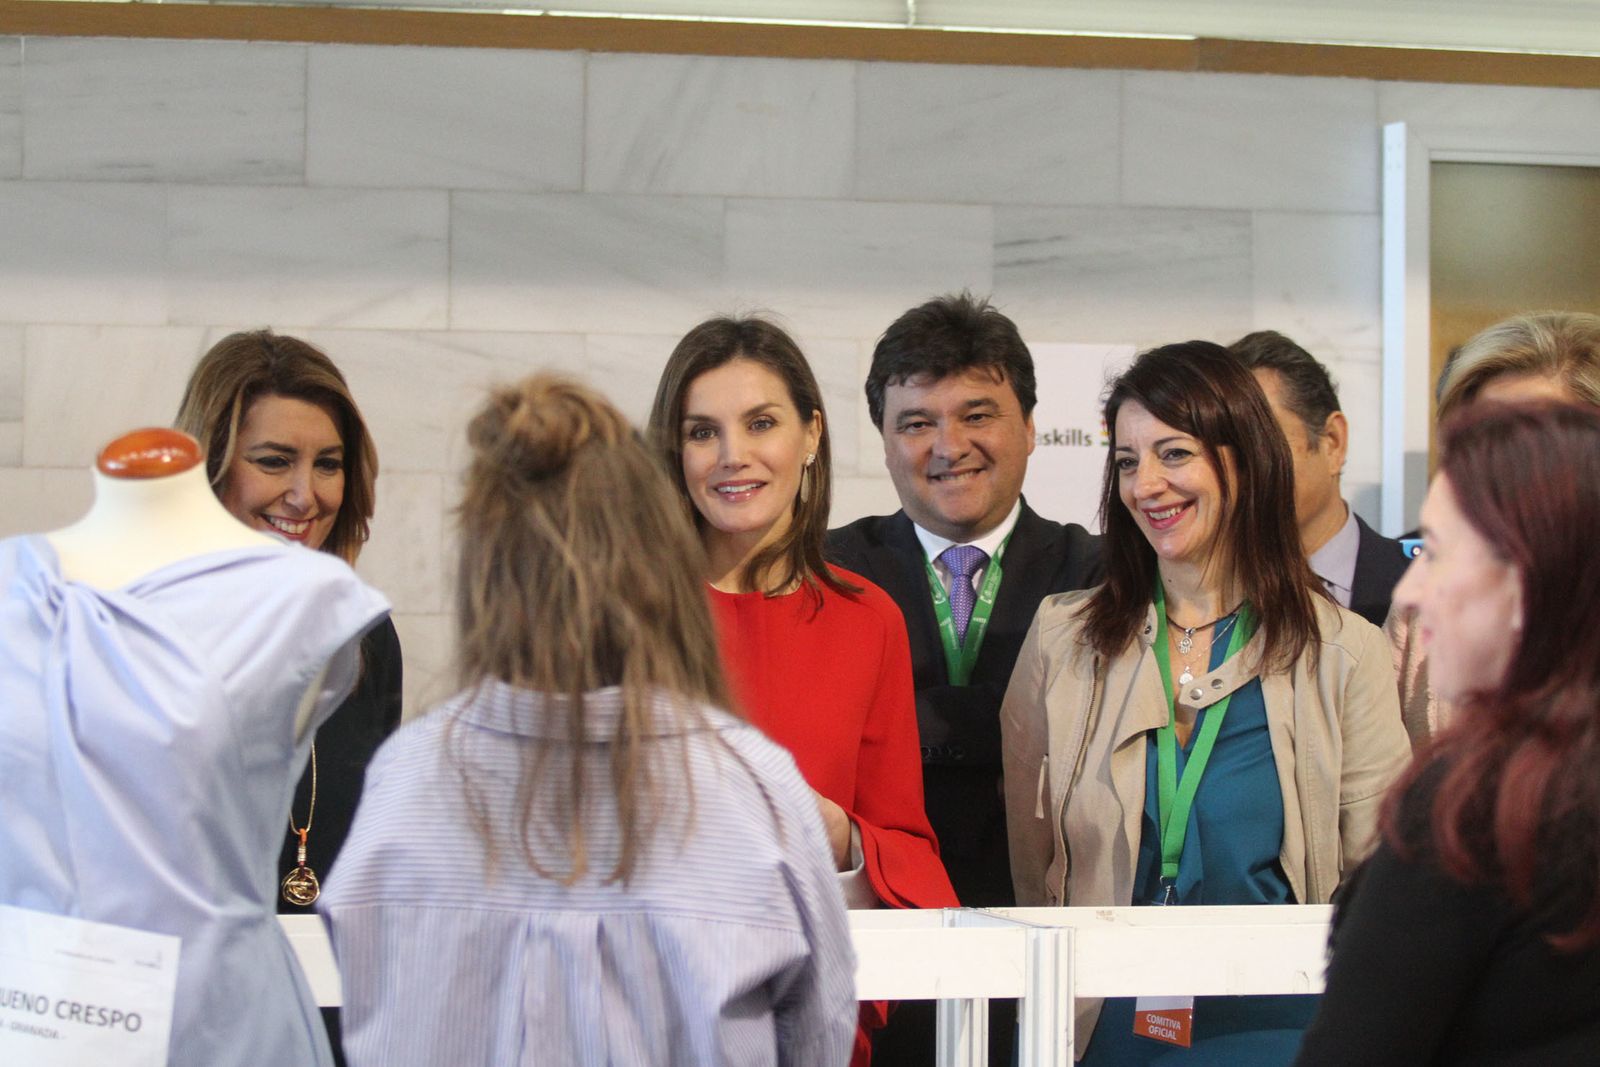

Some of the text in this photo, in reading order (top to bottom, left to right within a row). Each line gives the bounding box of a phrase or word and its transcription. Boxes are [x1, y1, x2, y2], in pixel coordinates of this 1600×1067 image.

[55, 1000, 142, 1032] CRESPO
[1146, 1013, 1181, 1030] COMITIVA
[1148, 1025, 1177, 1040] OFICIAL
